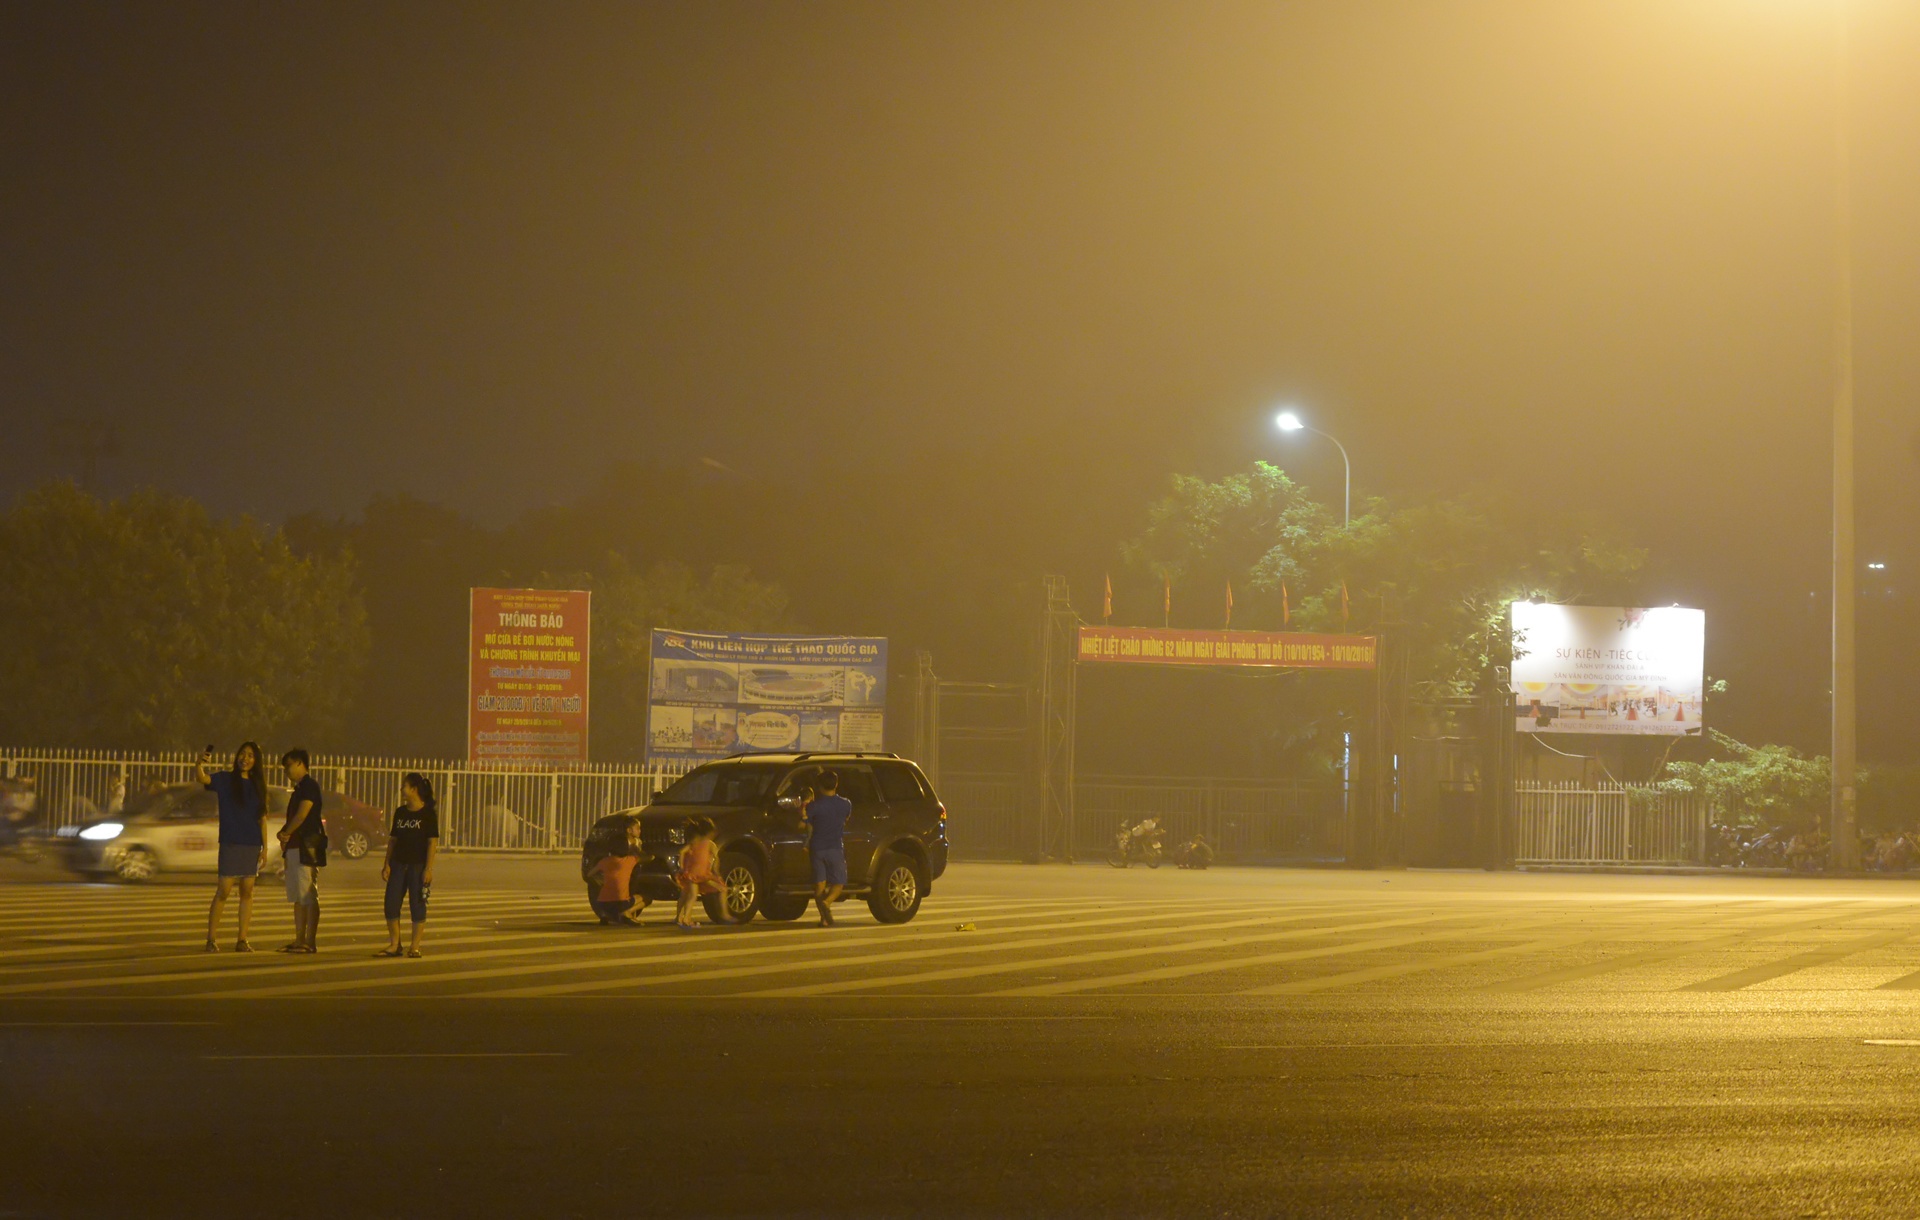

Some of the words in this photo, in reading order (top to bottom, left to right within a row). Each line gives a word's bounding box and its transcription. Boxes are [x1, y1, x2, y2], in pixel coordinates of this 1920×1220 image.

[498, 611, 537, 628] THÔNG
[540, 612, 563, 628] BÁO
[485, 630, 496, 645] MỞ
[536, 633, 554, 646] NƯỚC
[555, 634, 574, 647] NÓNG
[480, 647, 489, 660] VÀ
[491, 649, 518, 661] CHƯƠNG
[520, 648, 539, 661] TRÌNH
[691, 639, 714, 650] KHU
[795, 645, 823, 654] THAO
[827, 642, 856, 655] QUỐC
[859, 645, 878, 655] GIA
[1081, 634, 1102, 658] NHIỆT
[1103, 634, 1119, 658] LIỆT
[1120, 636, 1140, 656] CHÀO
[1142, 636, 1164, 657] MỪNG
[1165, 640, 1175, 657] 62
[1176, 638, 1193, 658] NĂM
[1194, 638, 1214, 658] NGÀY
[1216, 635, 1230, 659] GIẢI
[1231, 639, 1256, 660] PHÓNG
[1257, 637, 1271, 660] THỦ
[1272, 641, 1282, 660] ĐÔ
[1556, 648, 1572, 660] SỰ
[1575, 648, 1601, 661] KIỆN
